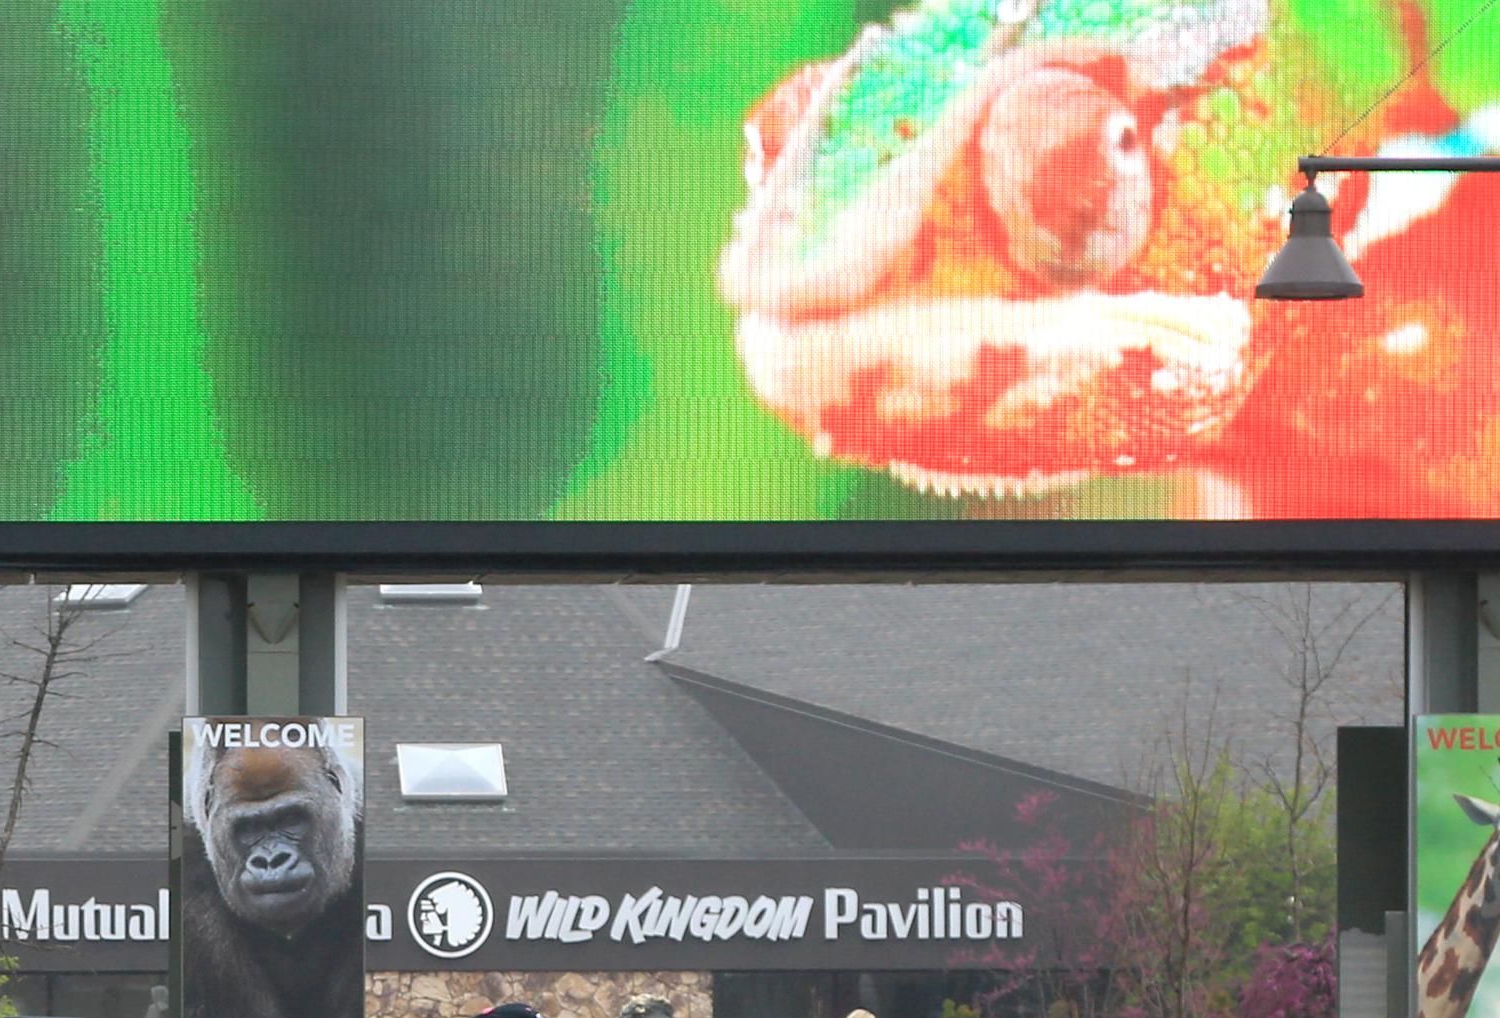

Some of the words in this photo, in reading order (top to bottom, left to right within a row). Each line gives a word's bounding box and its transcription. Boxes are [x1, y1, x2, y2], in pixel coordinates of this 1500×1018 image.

[192, 722, 356, 748] WELCOME
[1427, 726, 1500, 750] WEL
[2, 888, 170, 941] Mutual
[506, 890, 611, 943] WILD
[824, 887, 1024, 940] Pavilion
